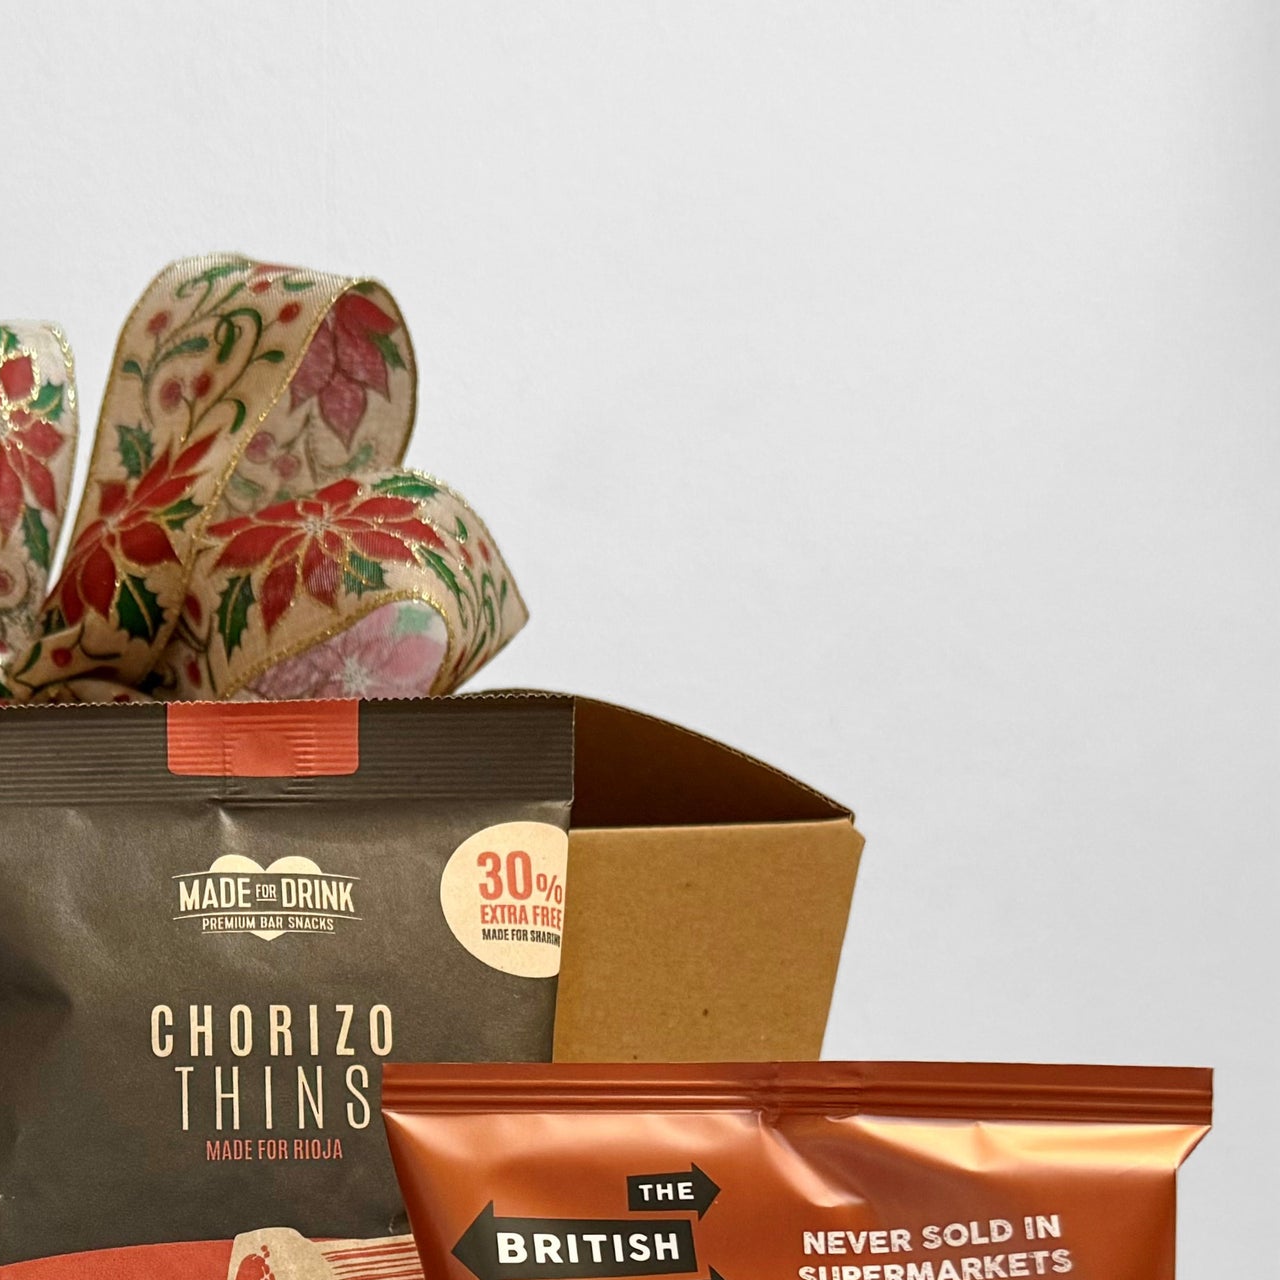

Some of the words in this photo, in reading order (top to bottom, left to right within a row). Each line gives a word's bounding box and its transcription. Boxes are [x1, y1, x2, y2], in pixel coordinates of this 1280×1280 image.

[476, 850, 563, 905] 30%
[179, 877, 252, 912] MADE
[255, 883, 277, 899] FOR
[281, 877, 355, 913] DRINK
[202, 916, 256, 931] PREMIUM
[260, 916, 283, 930] BAR
[288, 916, 334, 931] SNACKS
[480, 904, 529, 925] EXTRA
[532, 905, 562, 932] FREE
[482, 928, 509, 941] MADE
[511, 928, 529, 942] FOR
[150, 1003, 395, 1058] CHORIZO
[173, 1063, 373, 1131] THINS
[206, 1139, 253, 1161] MADE
[258, 1139, 289, 1160] FOR
[293, 1138, 343, 1160] RIOJA
[638, 1181, 695, 1202] THE
[496, 1231, 681, 1265] BRITISH
[802, 1228, 914, 1256] NEVER
[921, 1218, 1014, 1250] SOLD
[1023, 1213, 1062, 1241] IN
